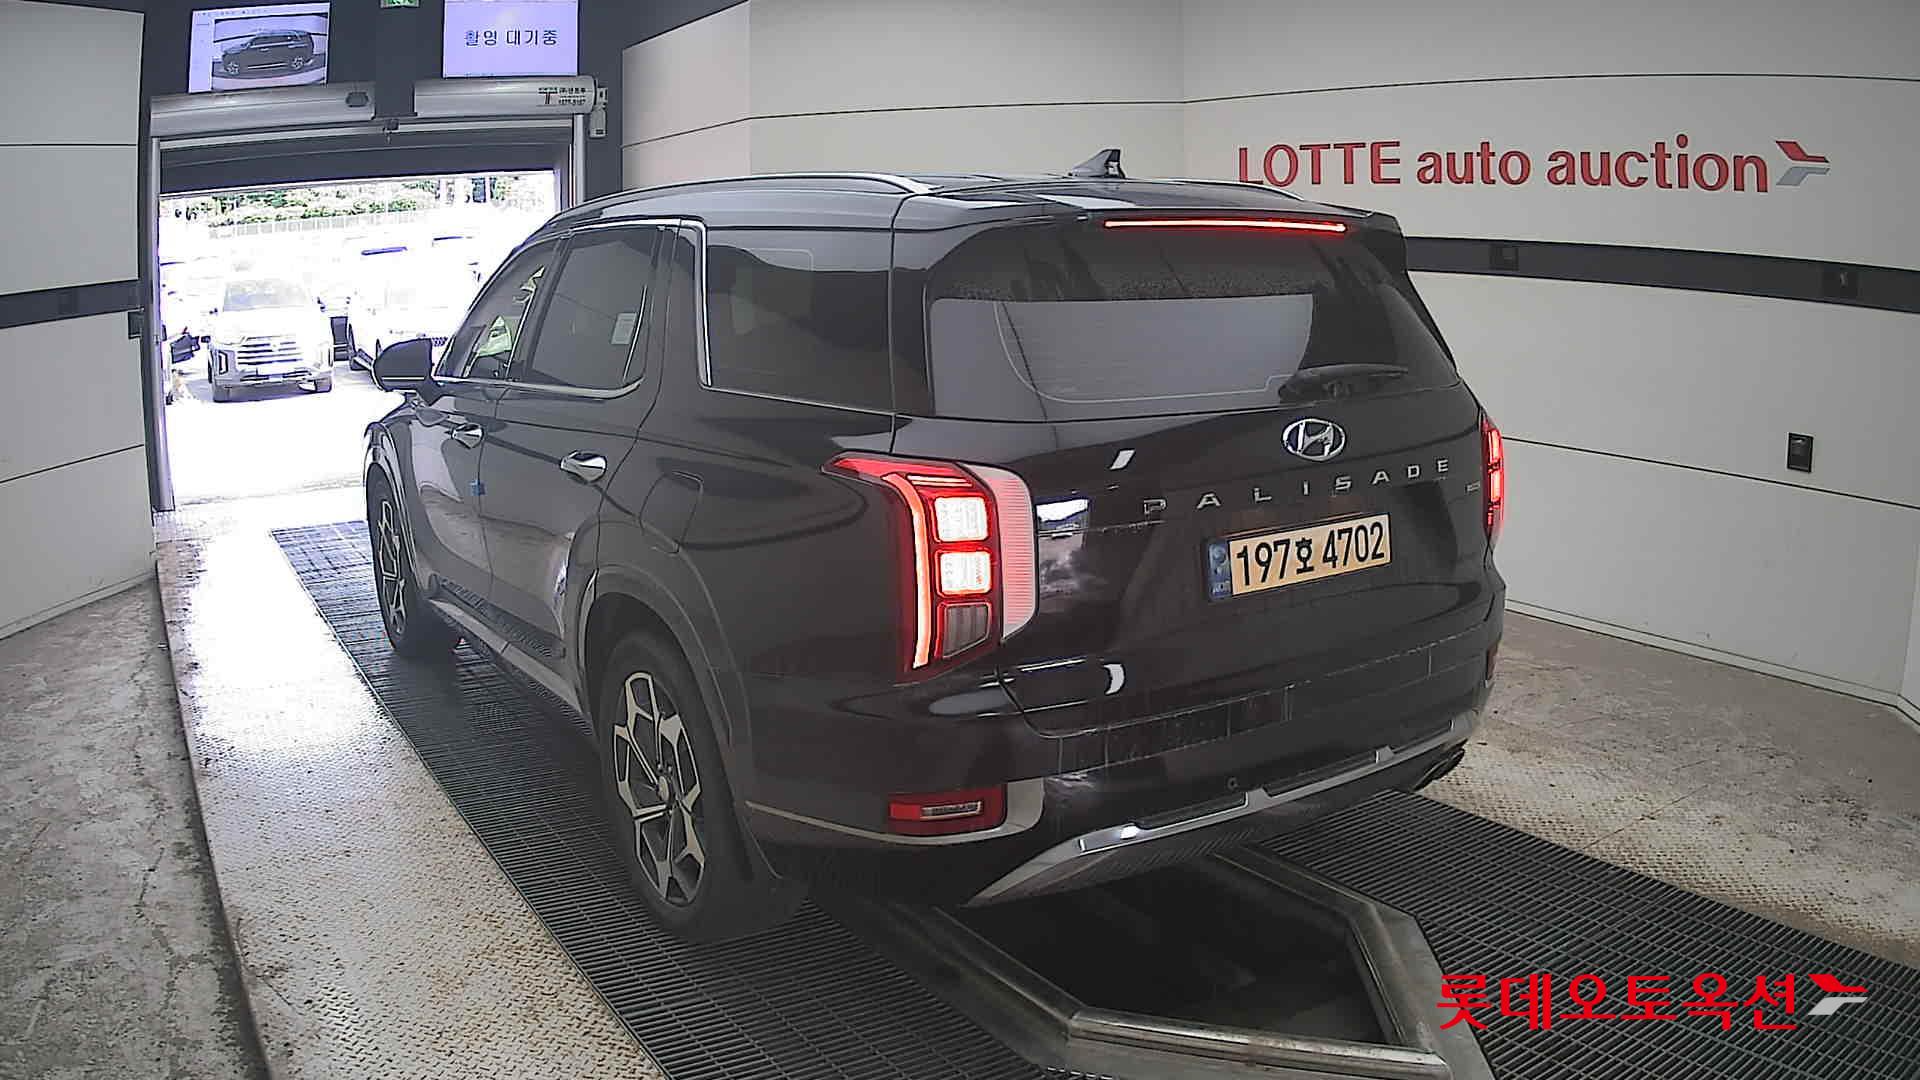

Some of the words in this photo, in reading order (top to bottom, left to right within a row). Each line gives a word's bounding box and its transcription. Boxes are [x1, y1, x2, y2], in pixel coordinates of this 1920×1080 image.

[506, 29, 557, 45] 대기중
[1239, 141, 1400, 187] LOTTE
[1417, 142, 1532, 185] auto
[1547, 134, 1769, 193] auction
[1144, 458, 1449, 515] PALISADE
[1236, 537, 1315, 587] 197호
[1322, 521, 1385, 569] 4702
